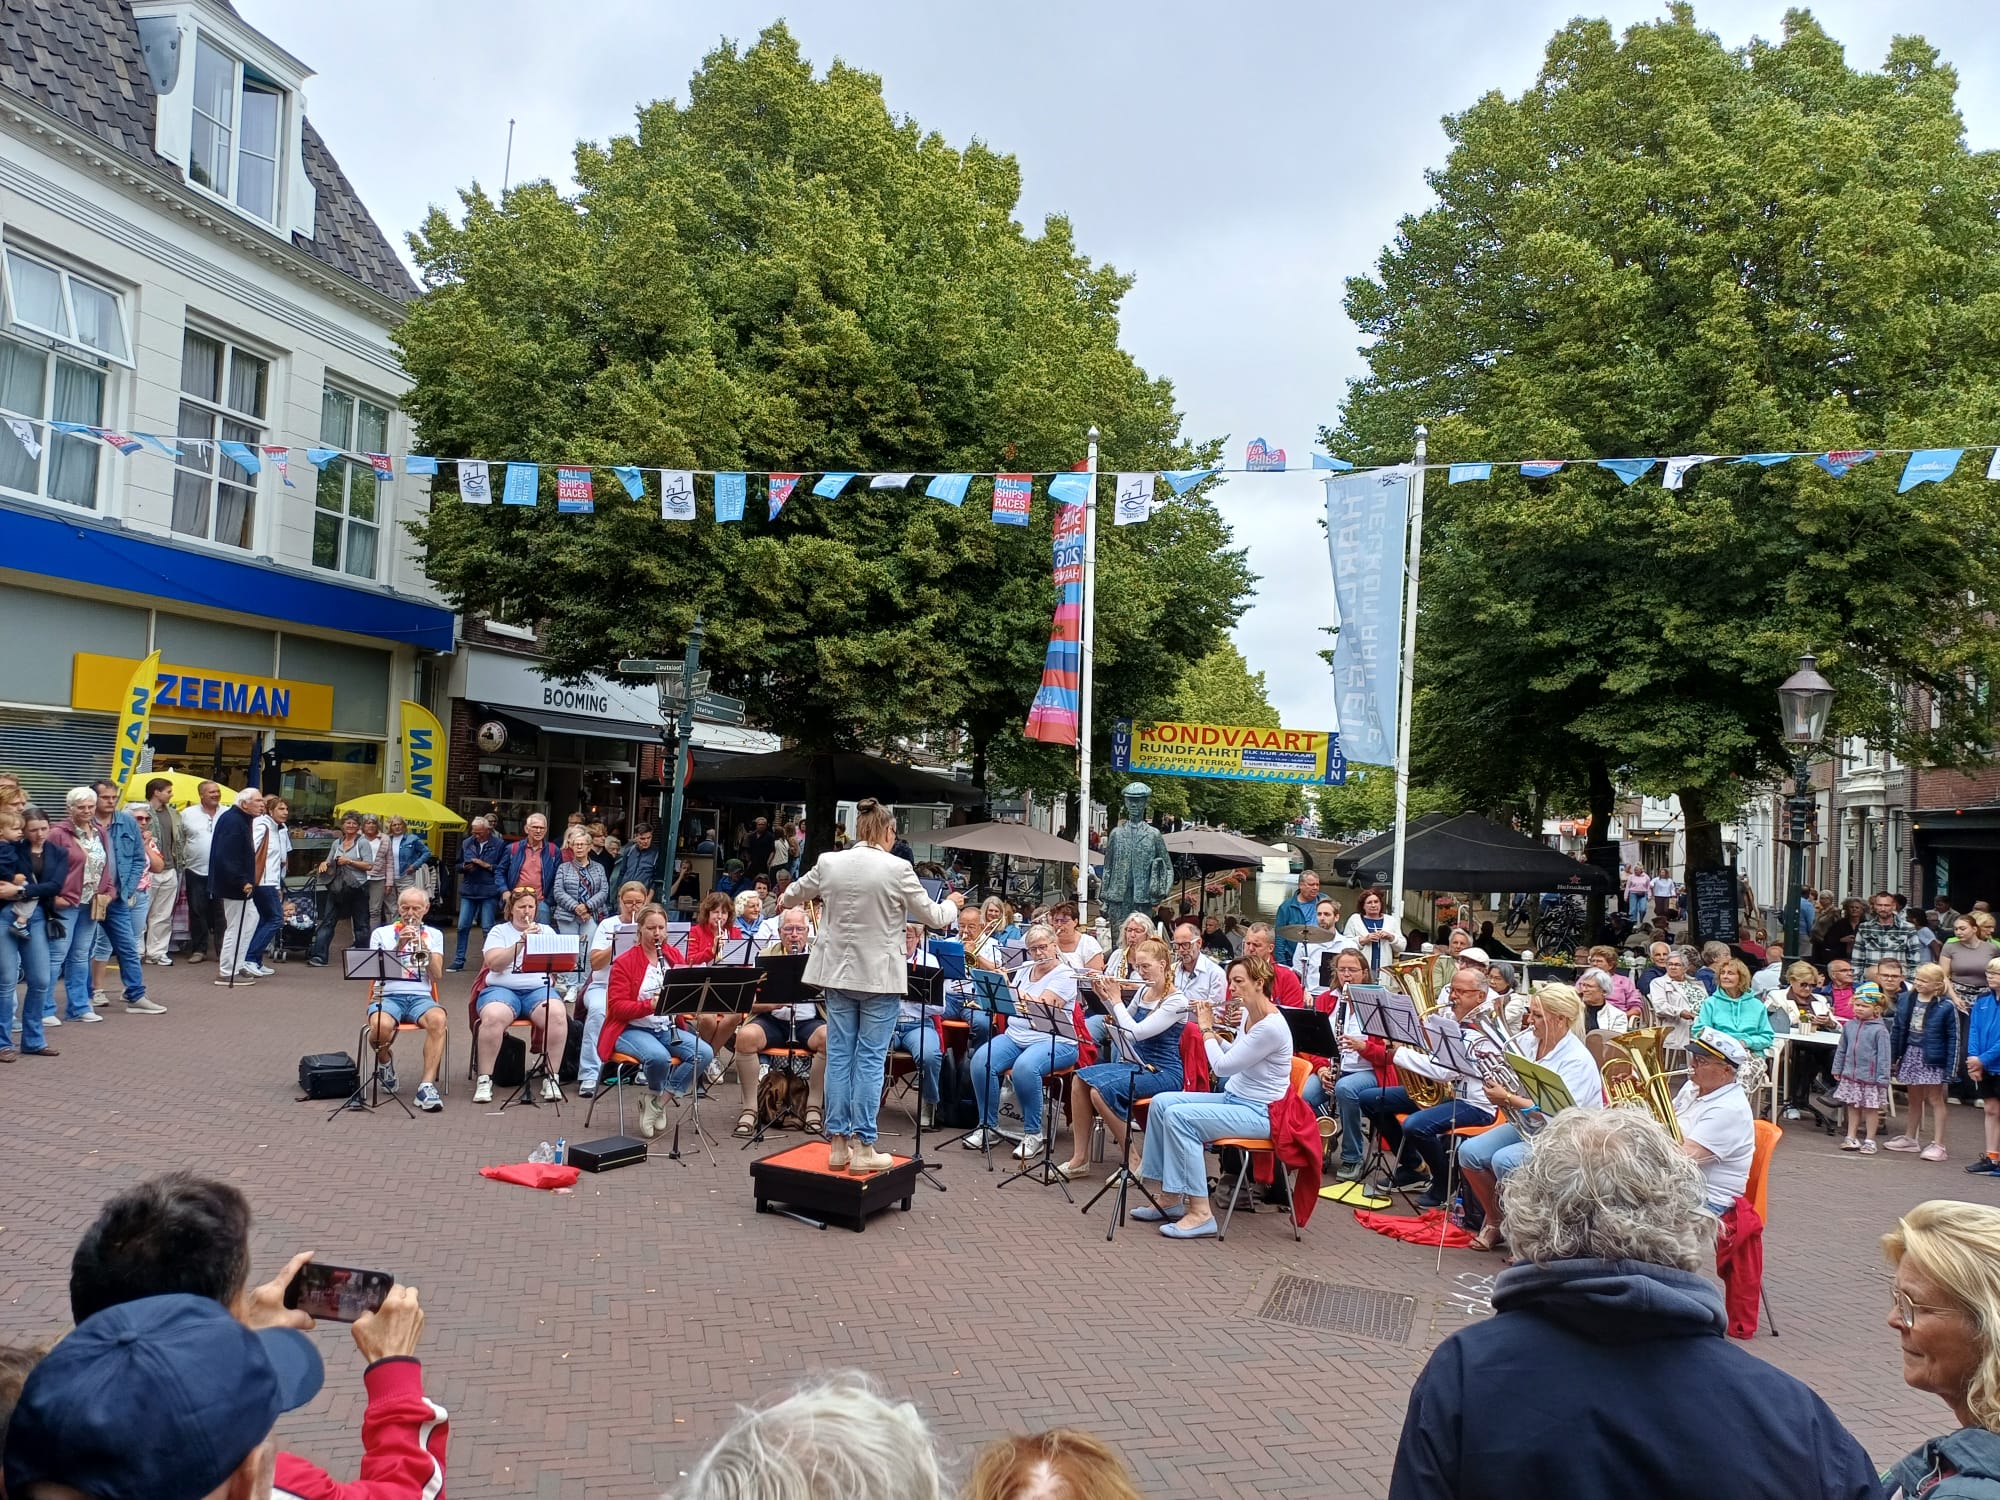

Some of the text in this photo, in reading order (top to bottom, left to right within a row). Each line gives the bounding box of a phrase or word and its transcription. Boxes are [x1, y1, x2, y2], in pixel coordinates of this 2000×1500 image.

[560, 469, 579, 478] TALL
[560, 479, 585, 489] SHIPS
[997, 478, 1020, 489] TALL
[560, 488, 588, 498] RACES
[996, 488, 1024, 500] SHIPS
[995, 498, 1026, 510] RACES
[655, 663, 682, 671] Zoutsloot
[155, 673, 290, 717] ZEEMAN
[543, 687, 608, 713] BOOMING
[696, 705, 714, 716] Station
[1140, 725, 1319, 751] RONDVAART
[1139, 743, 1241, 758] RUNDFAHRT
[1139, 754, 1196, 766] OPSTAPPEN
[1200, 758, 1237, 768] TERRAS
